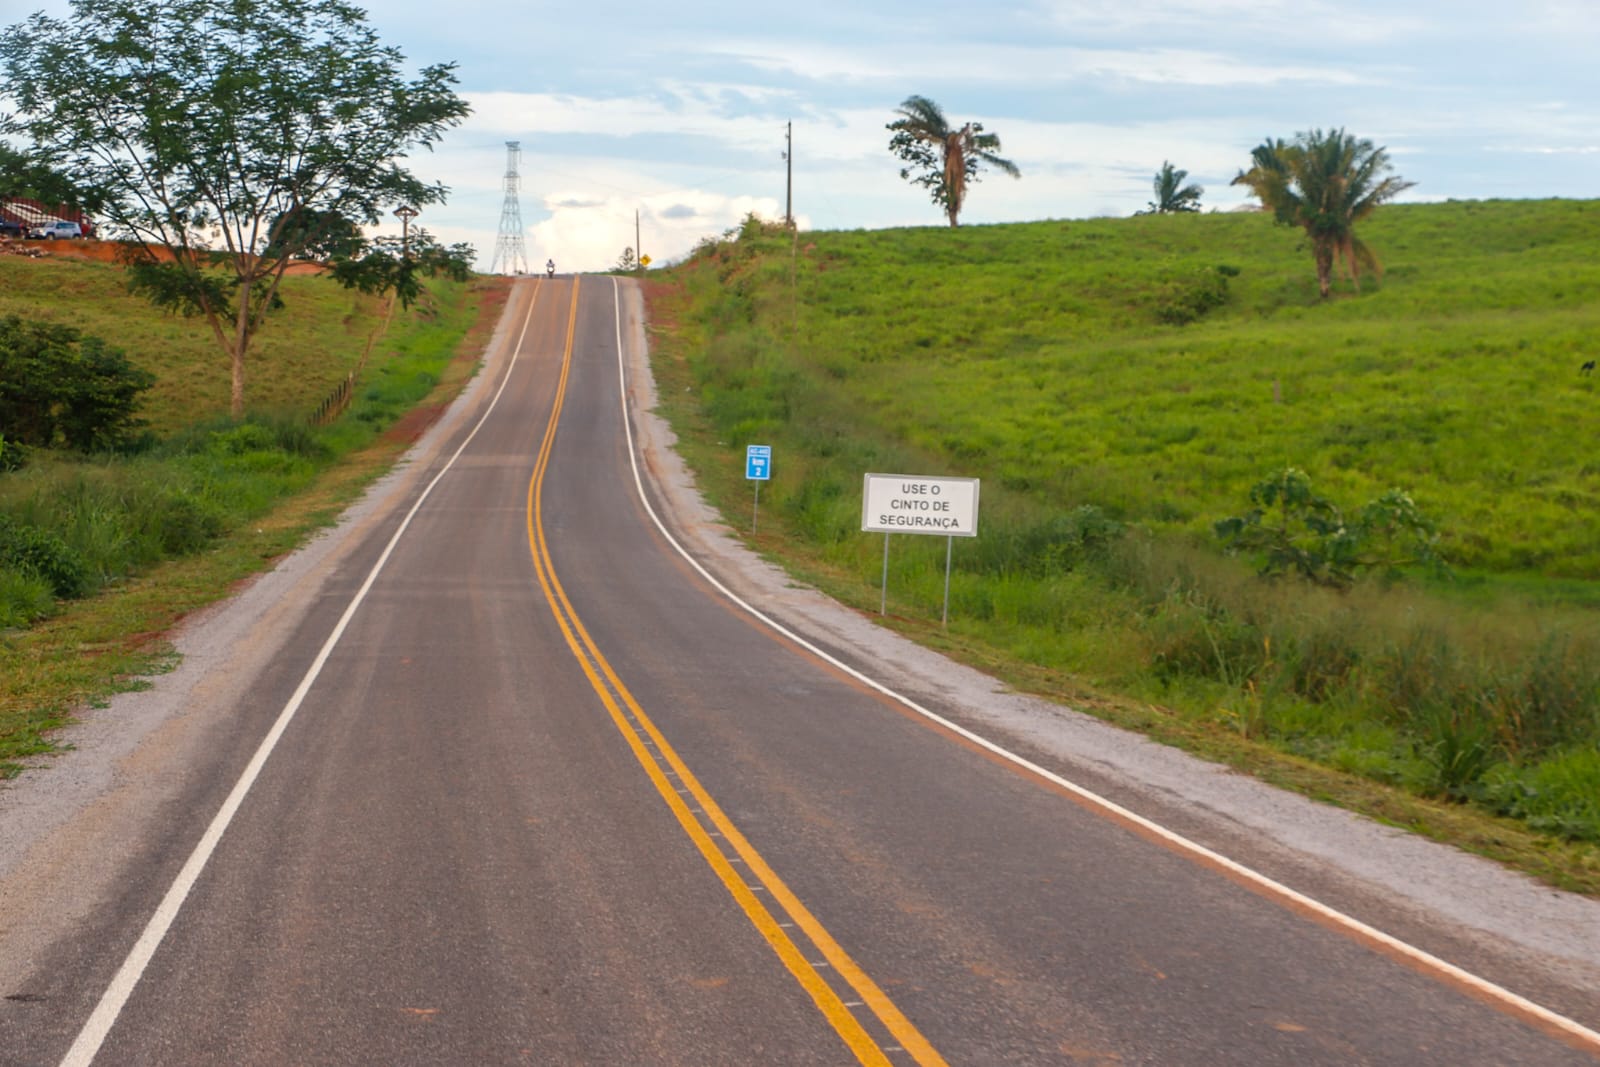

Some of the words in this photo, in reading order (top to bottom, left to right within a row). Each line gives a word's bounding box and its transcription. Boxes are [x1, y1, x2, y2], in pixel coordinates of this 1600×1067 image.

[902, 483, 927, 495] USE
[930, 485, 941, 495] O
[890, 499, 930, 511] CINTO
[932, 501, 950, 512] DE
[879, 515, 959, 529] SEGURANÇA
